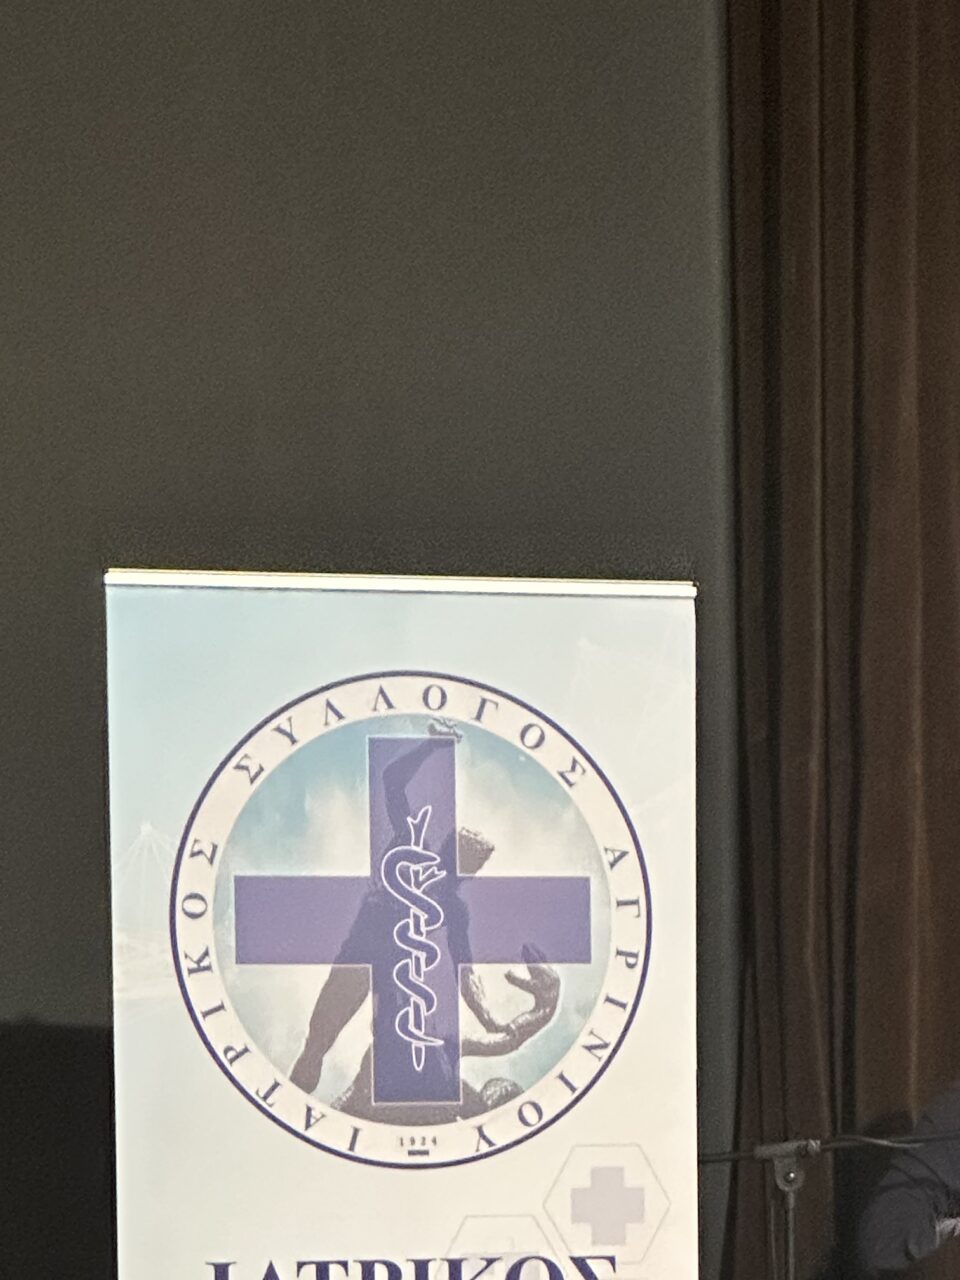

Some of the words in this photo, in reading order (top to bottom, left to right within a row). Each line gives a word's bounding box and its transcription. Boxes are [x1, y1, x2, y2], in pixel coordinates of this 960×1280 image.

[235, 684, 587, 788] ΣΥΛΛΟΓΟΣ
[181, 838, 361, 1152] ΙΑΤΡΙΚΟΣ
[475, 845, 641, 1152] ΑΓΡΙΝΙΟΥ
